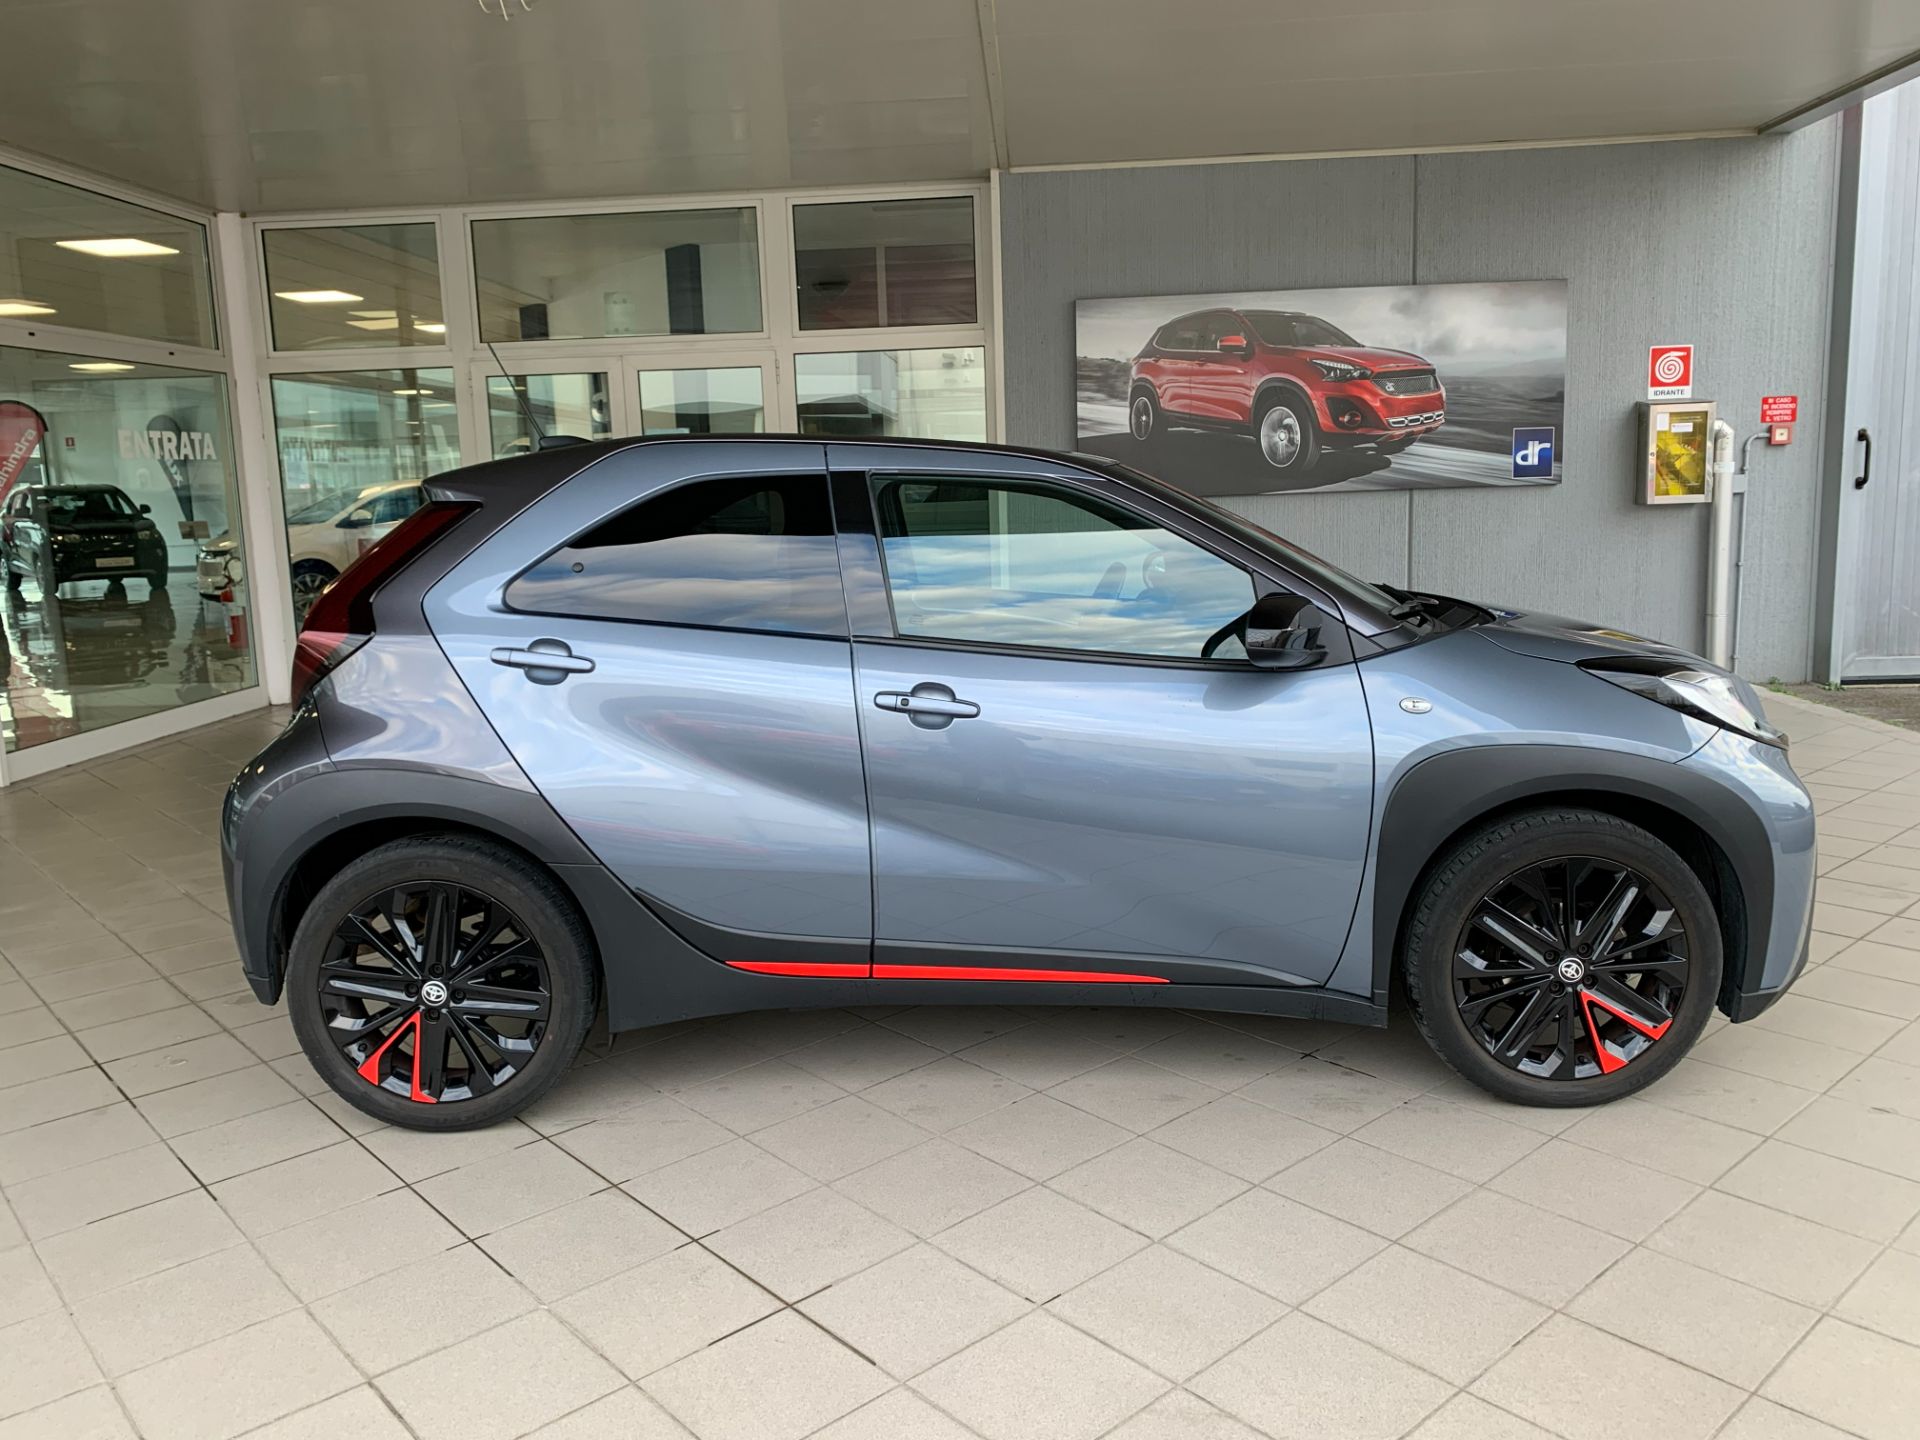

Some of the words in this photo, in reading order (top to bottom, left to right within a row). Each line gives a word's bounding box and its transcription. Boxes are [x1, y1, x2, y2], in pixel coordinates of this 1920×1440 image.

[1653, 388, 1685, 397] IDRANTE
[117, 429, 217, 460] ENTRATA
[1515, 440, 1551, 465] dr
[0, 428, 37, 490] ahindra
